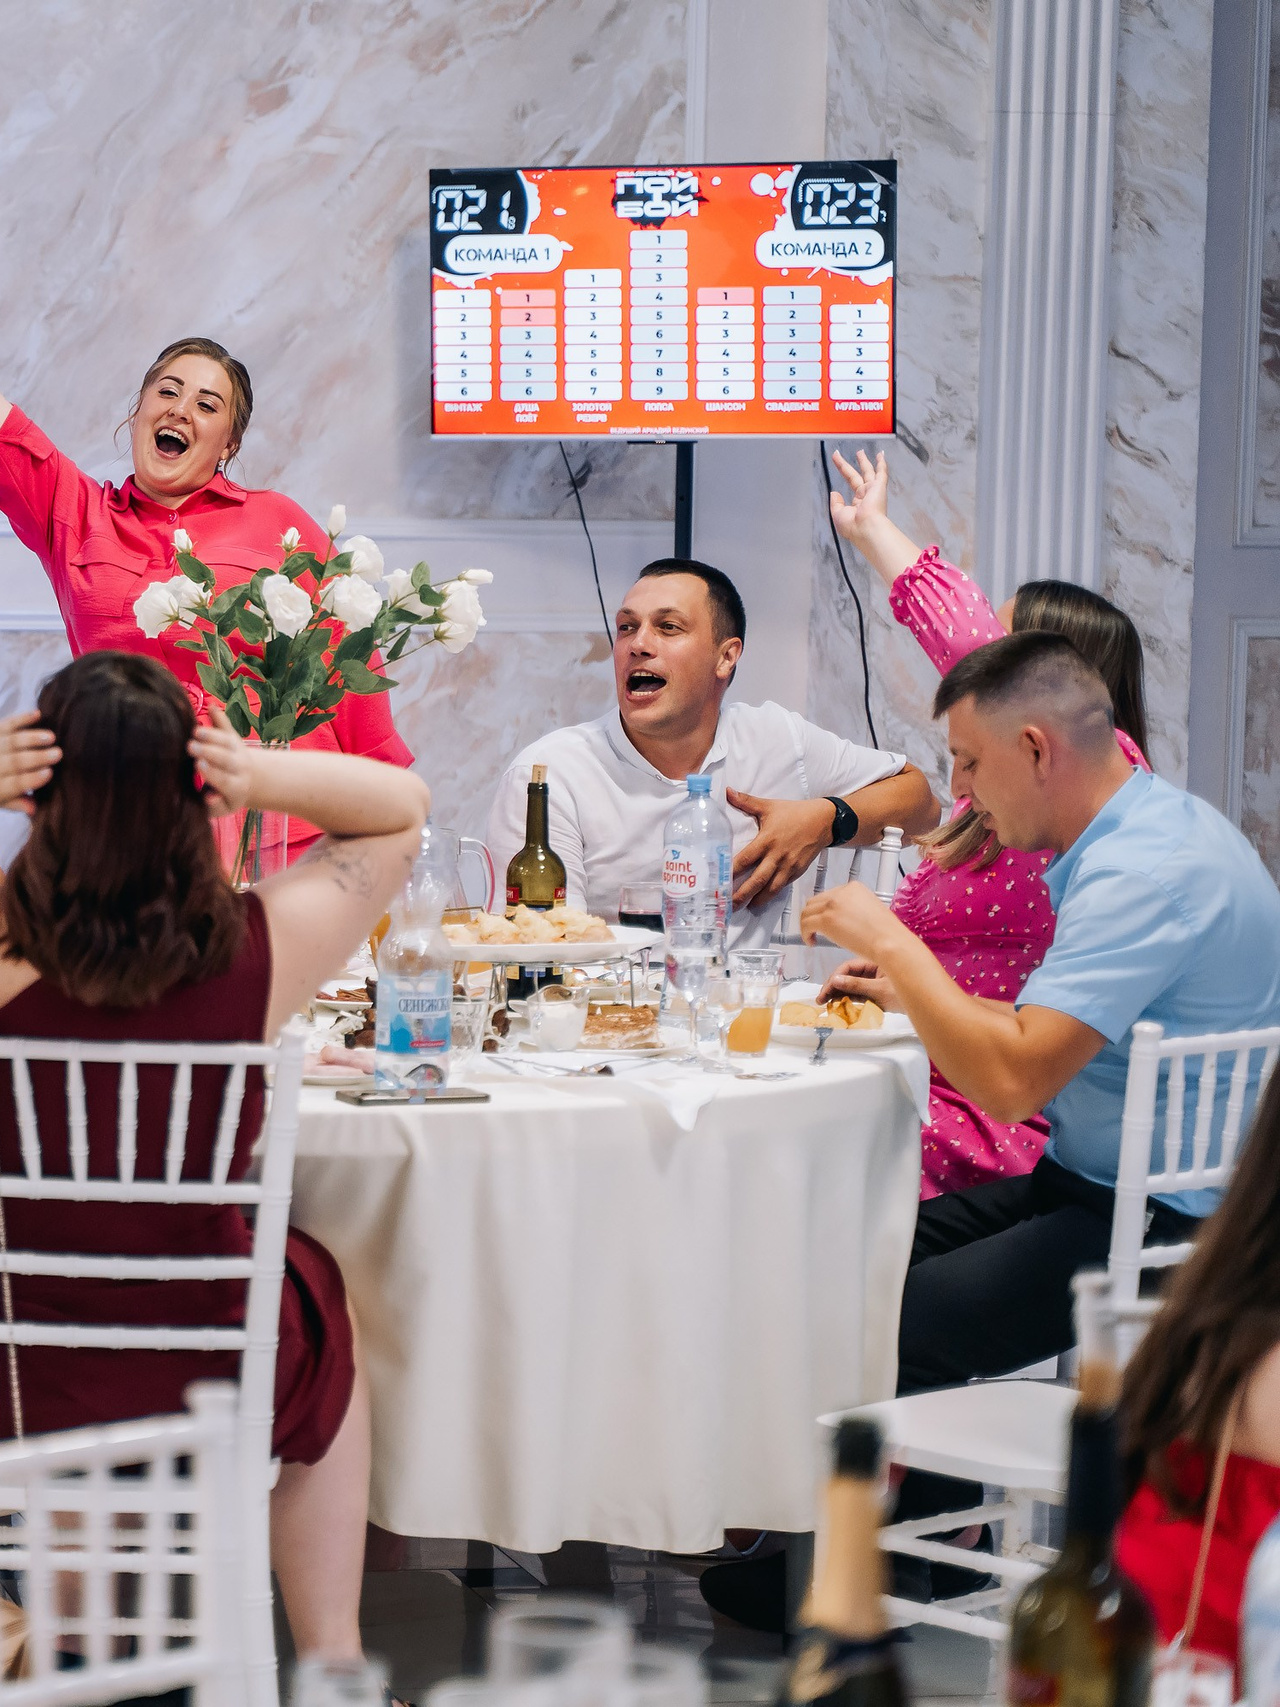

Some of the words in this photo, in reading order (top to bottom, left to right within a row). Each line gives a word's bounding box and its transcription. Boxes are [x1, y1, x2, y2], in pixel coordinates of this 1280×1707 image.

[616, 171, 699, 195] ПОЙ
[616, 194, 699, 218] БОЙ
[802, 182, 882, 225] 023
[436, 189, 512, 231] 021
[771, 241, 859, 259] КОМАНДА
[864, 241, 873, 256] 2
[454, 247, 539, 264] КОМАНДА
[544, 247, 550, 261] 1
[655, 253, 663, 264] 2
[655, 272, 663, 283] 3
[590, 293, 597, 303] 2
[655, 292, 664, 301] 4
[460, 313, 467, 323] 2
[525, 312, 532, 322] 2
[590, 311, 597, 321] 3
[655, 310, 663, 321] 5
[722, 310, 730, 320] 2
[789, 309, 797, 320] 2
[460, 331, 467, 341] 3
[524, 330, 532, 340] 3
[589, 330, 598, 340] 4
[655, 329, 664, 339] 6
[722, 328, 730, 339] 3
[788, 328, 797, 338] 3
[856, 327, 864, 338] 2
[459, 350, 468, 359] 4
[524, 349, 533, 359] 4
[590, 349, 597, 359] 5
[655, 348, 664, 358] 7
[721, 348, 730, 358] 4
[788, 347, 797, 358] 4
[855, 347, 864, 357] 3
[460, 368, 468, 378] 5
[525, 368, 533, 378] 5
[590, 367, 598, 377] 6
[655, 367, 664, 377] 8
[722, 367, 730, 377] 5
[789, 366, 797, 377] 5
[855, 366, 864, 376] 4
[460, 386, 468, 397] 6
[524, 386, 533, 396] 6
[589, 386, 598, 396] 7
[655, 385, 664, 396] 9
[722, 385, 730, 395] 6
[788, 385, 797, 395] 6
[856, 384, 864, 395] 5
[513, 402, 539, 414] ДУША
[644, 402, 675, 412] ПОПСА
[705, 401, 747, 412] ШАНСОН
[835, 401, 884, 411] МУЛЬТИКИ
[665, 860, 693, 873] saint
[662, 871, 697, 889] spring
